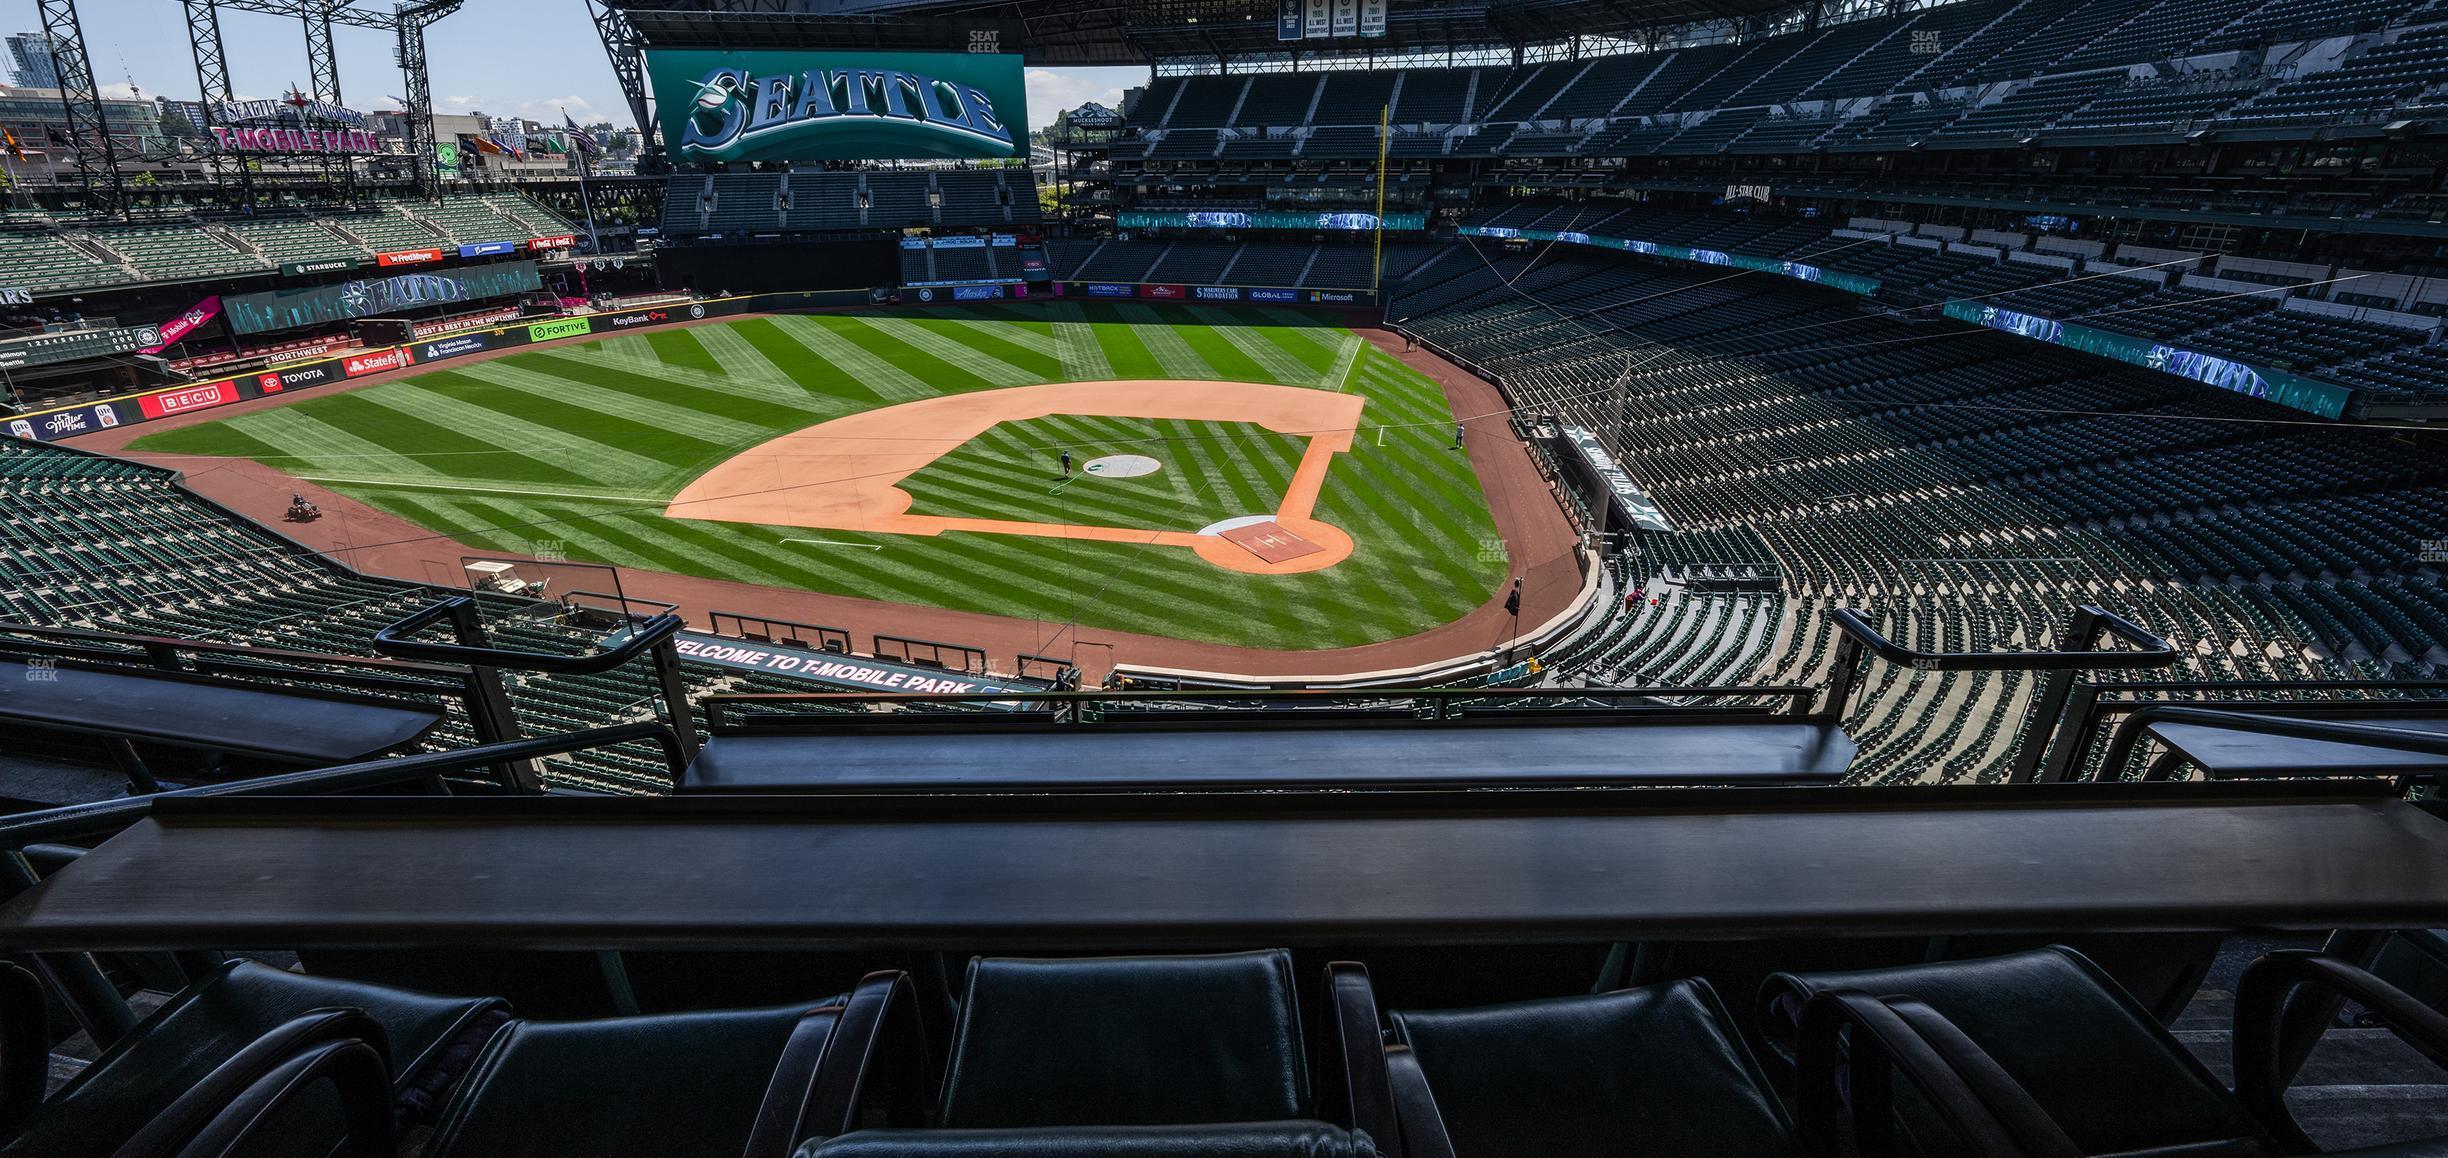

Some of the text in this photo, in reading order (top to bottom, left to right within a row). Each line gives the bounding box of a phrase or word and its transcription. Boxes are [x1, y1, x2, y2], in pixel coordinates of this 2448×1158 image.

[224, 99, 367, 126] SEATTLE MARINERS
[682, 68, 1014, 151] SEATTLE
[211, 126, 381, 151] T-MOBILE PARK
[1753, 185, 1771, 202] CLUB
[306, 261, 347, 271] STARBUCKS
[0, 287, 34, 305] RS
[958, 287, 988, 298] Alaska
[1252, 291, 1281, 299] GLOBAL
[1321, 293, 1353, 301] Microsoft
[445, 322, 462, 331] BEST
[472, 318, 485, 326] THE
[613, 314, 649, 326] KeyBank
[166, 320, 189, 336] Mobile
[547, 322, 586, 335] FORTIVE
[437, 338, 472, 349] Virginia Mason
[439, 342, 483, 355] Franciscan Health
[271, 346, 328, 363] NORTHWEST
[282, 369, 325, 384] TOYOTA
[97, 407, 111, 416] Lite
[12, 423, 29, 432] Lite
[45, 413, 84, 433] Miller
[67, 421, 87, 431] TIME
[765, 654, 801, 670] TO
[799, 660, 909, 687] T-MOBILE
[902, 676, 976, 693] PARK
